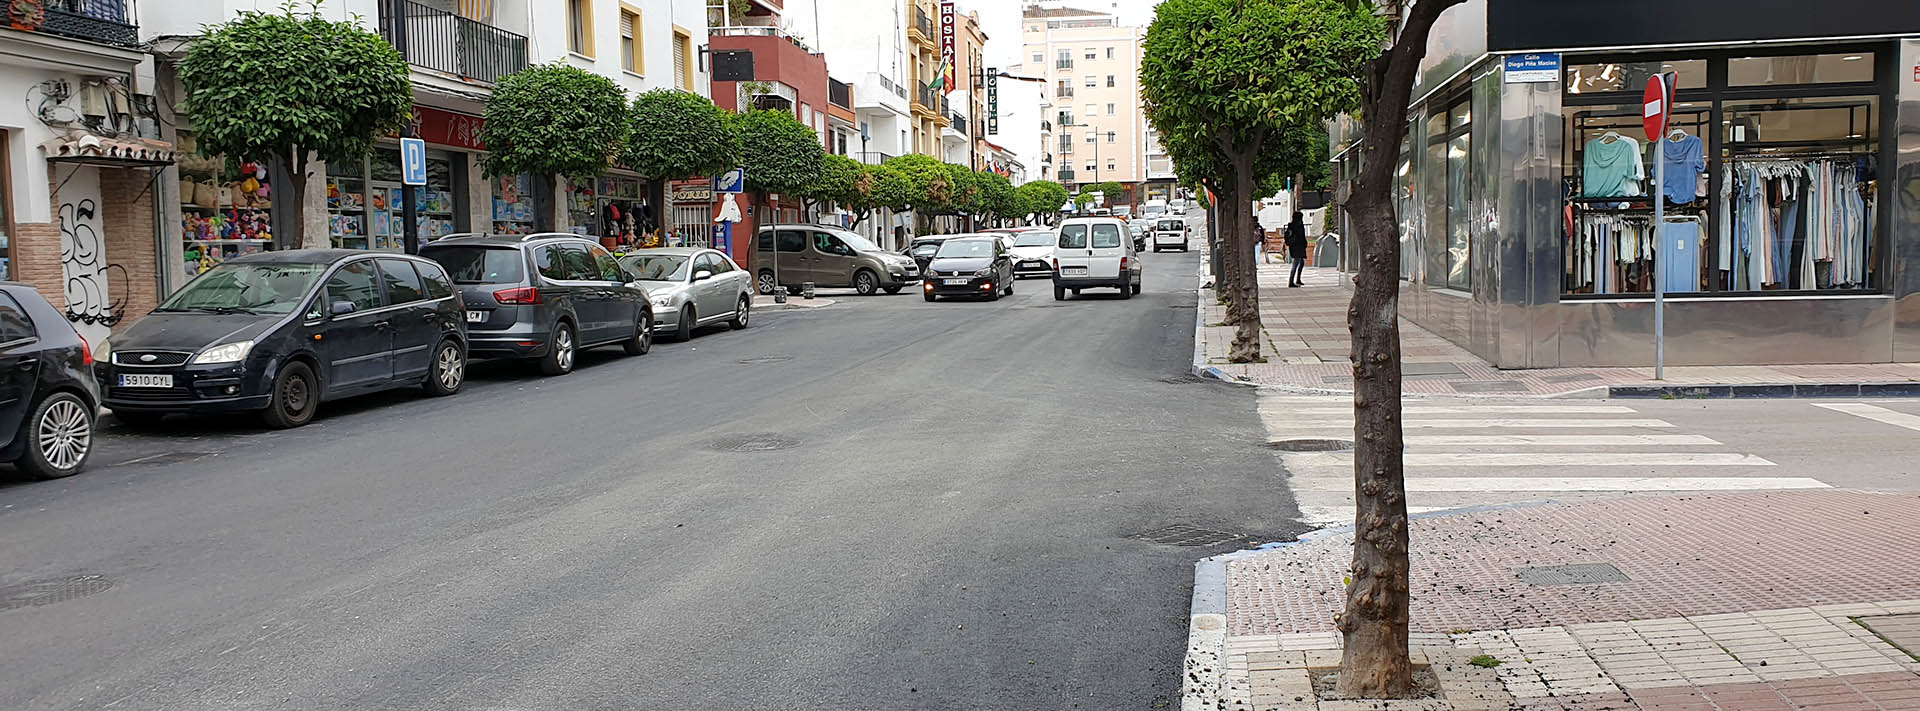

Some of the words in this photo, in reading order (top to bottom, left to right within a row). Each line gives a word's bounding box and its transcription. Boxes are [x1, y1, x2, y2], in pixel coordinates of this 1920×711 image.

[942, 6, 953, 69] HOSTA
[988, 70, 997, 112] HOTEL
[409, 144, 419, 180] P
[125, 375, 150, 386] 5910
[152, 375, 171, 387] CYL
